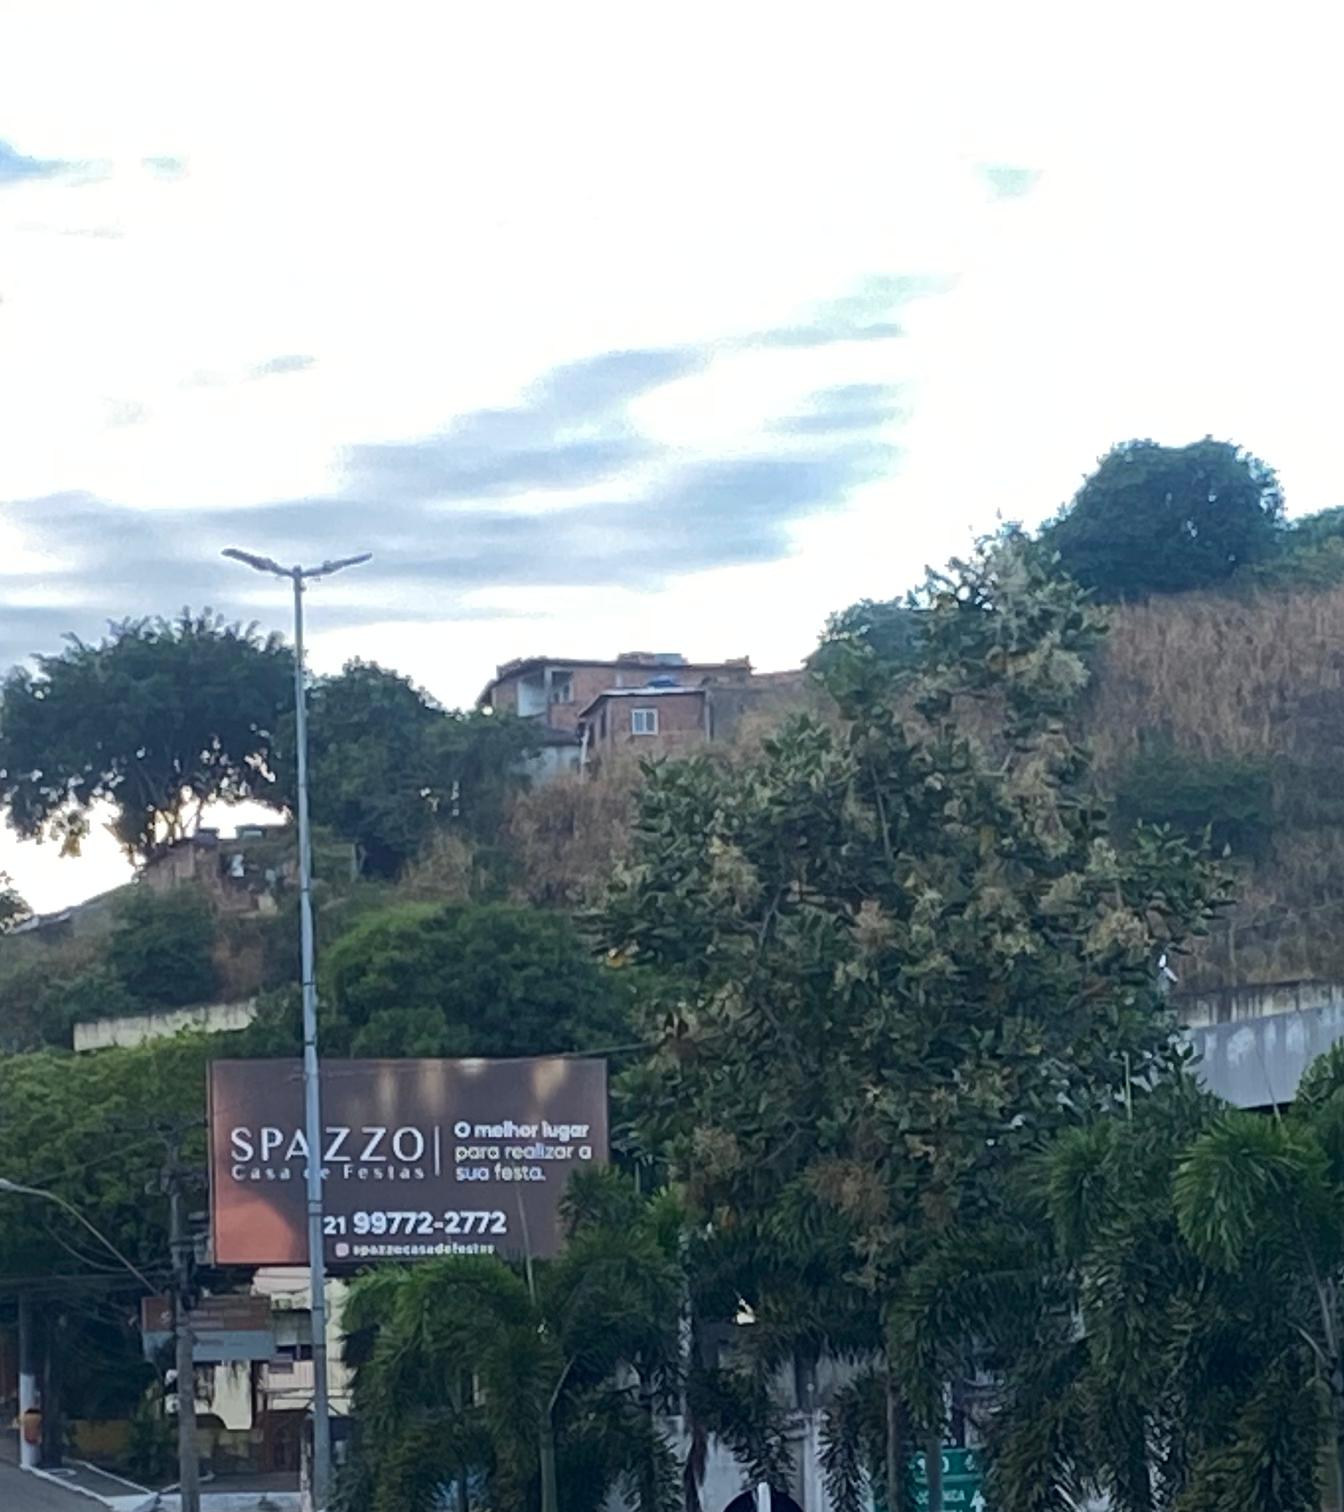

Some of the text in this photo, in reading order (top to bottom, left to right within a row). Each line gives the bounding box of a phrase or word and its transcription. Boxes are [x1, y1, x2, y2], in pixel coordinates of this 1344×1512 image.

[454, 1120, 590, 1142] O melhor lugar
[230, 1126, 425, 1162] SPAZZO
[455, 1142, 592, 1163] para realizar a
[231, 1164, 290, 1180] Casa
[343, 1164, 426, 1180] Festas
[455, 1162, 546, 1181] sua festa.
[323, 1211, 507, 1234] 21 99772-2772
